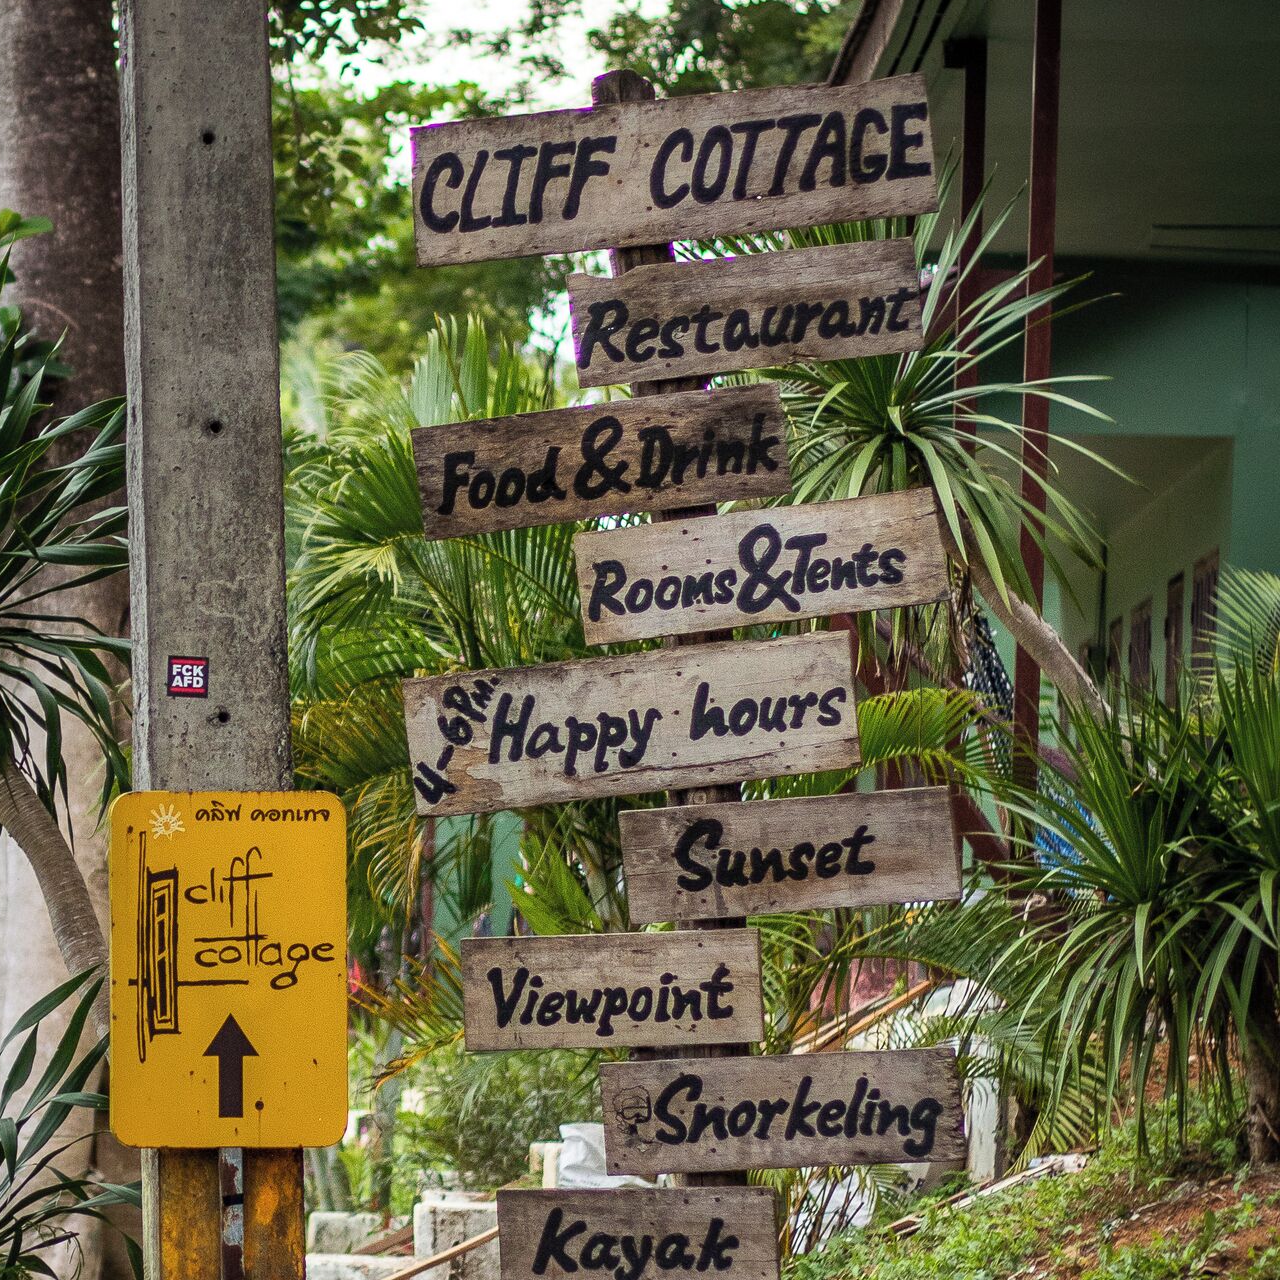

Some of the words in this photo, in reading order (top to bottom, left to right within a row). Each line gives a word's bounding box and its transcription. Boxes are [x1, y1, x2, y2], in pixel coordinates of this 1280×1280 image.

[420, 136, 617, 233] CLIFF
[649, 102, 932, 210] COTTAGE
[579, 285, 920, 370] Restaurant
[171, 675, 204, 688] AFD
[172, 664, 204, 677] FCK
[488, 692, 663, 777] Happy
[690, 681, 848, 742] hours
[184, 846, 273, 928] cliff
[673, 818, 876, 893] Sunset
[194, 890, 335, 990] cottage
[486, 961, 734, 1038] Viewpoint
[653, 1073, 944, 1158] Snorkeling
